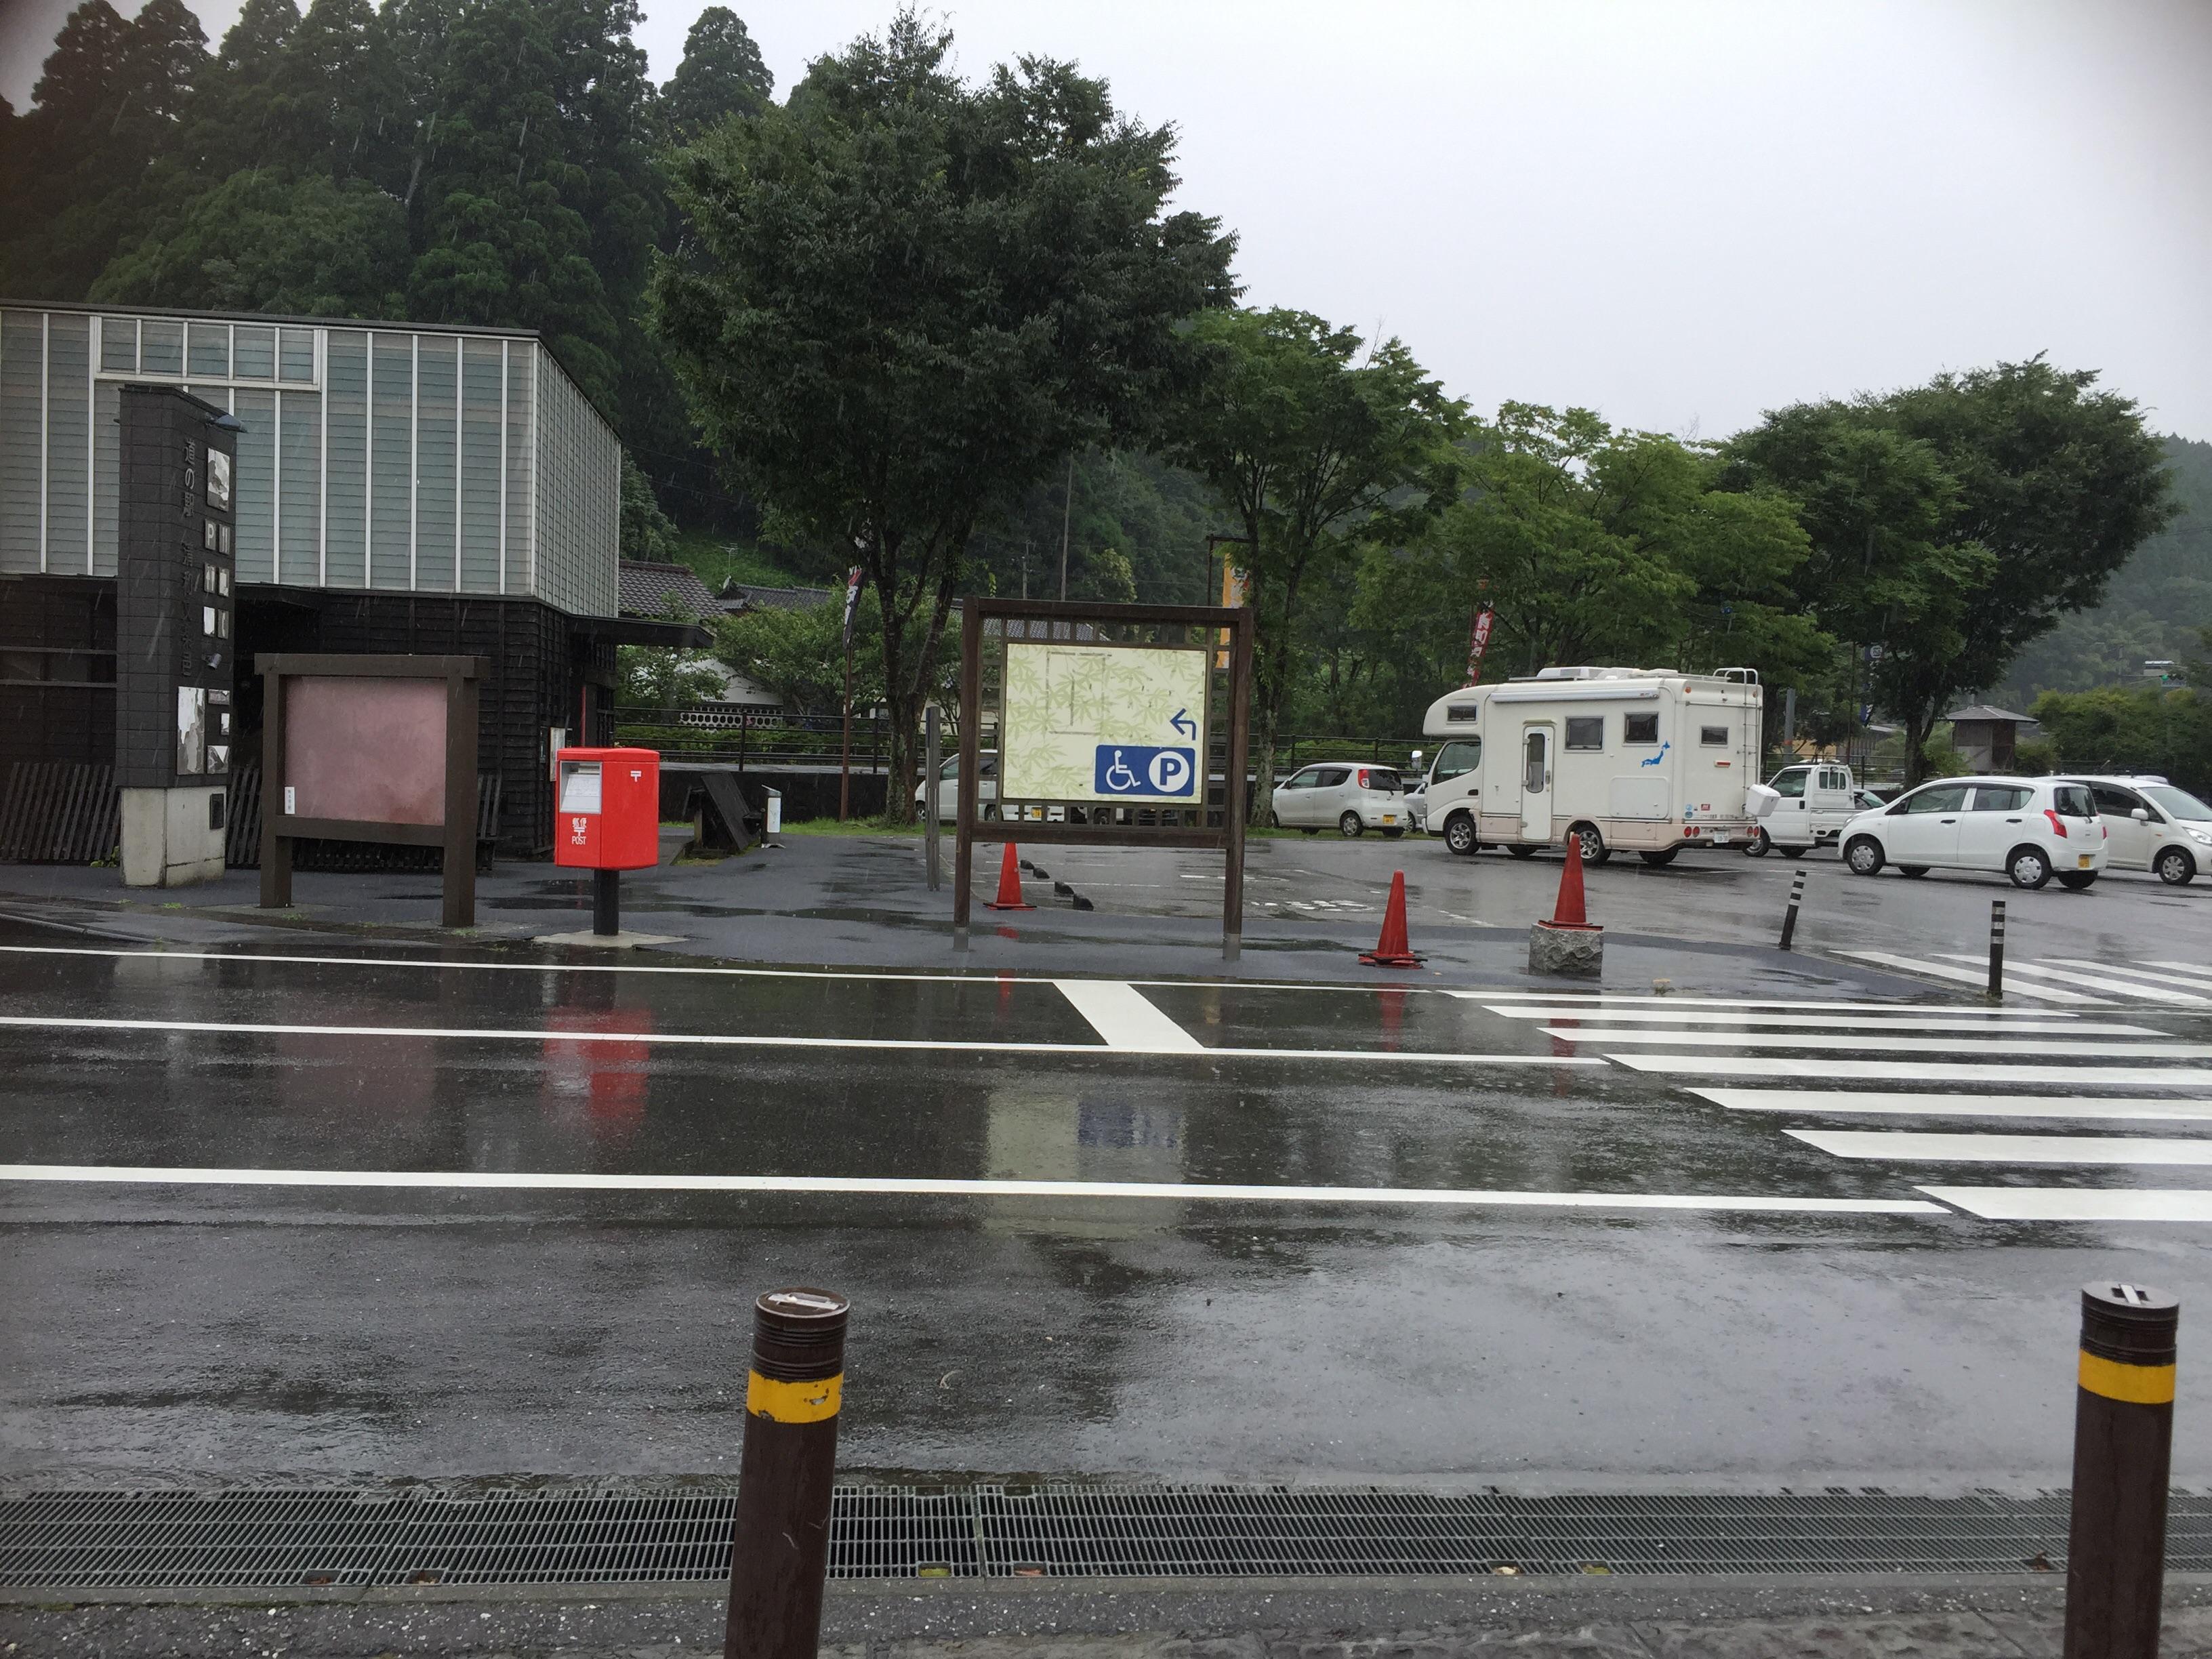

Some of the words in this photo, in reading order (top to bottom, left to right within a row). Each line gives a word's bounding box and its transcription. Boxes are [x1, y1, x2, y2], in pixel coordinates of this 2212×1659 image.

[183, 438, 196, 517] 道の駅
[207, 523, 214, 546] P
[1160, 758, 1181, 785] P
[571, 836, 587, 845] POST
